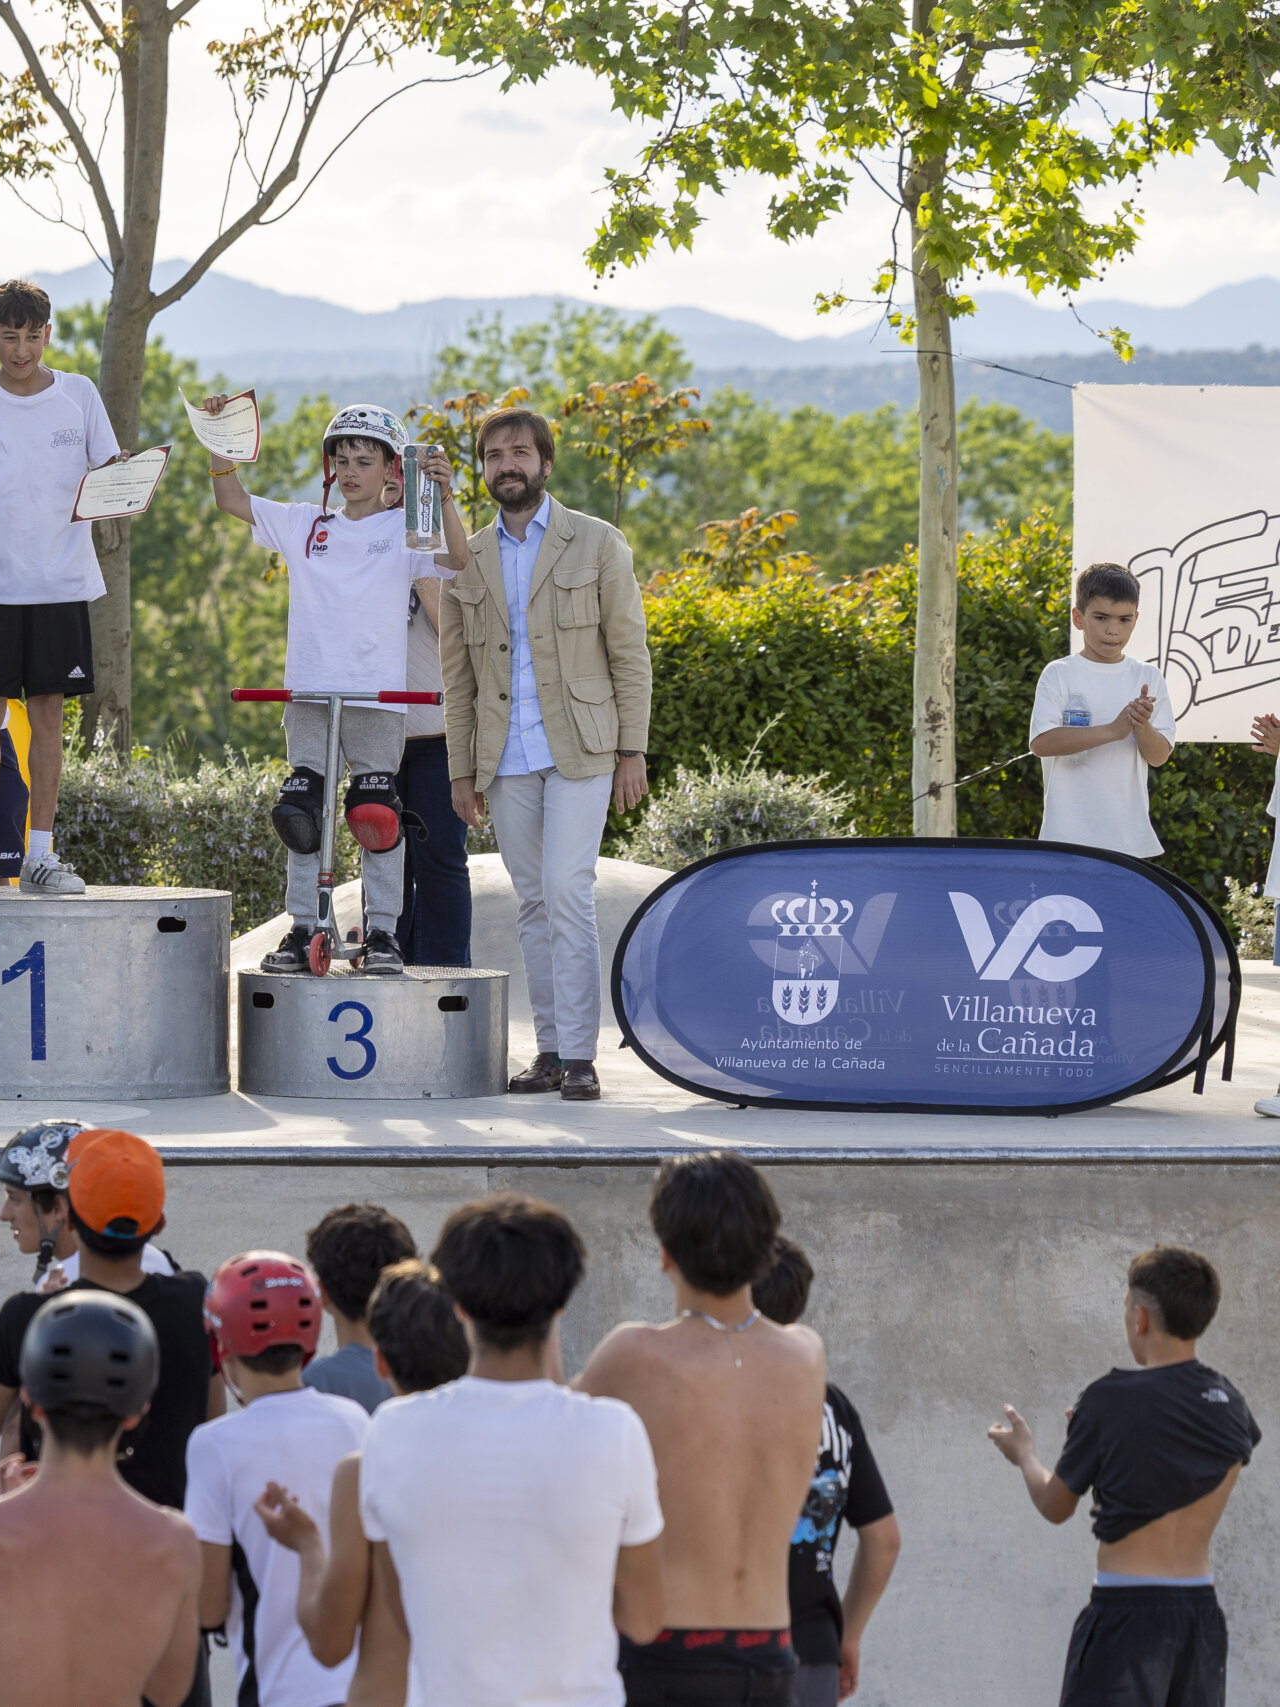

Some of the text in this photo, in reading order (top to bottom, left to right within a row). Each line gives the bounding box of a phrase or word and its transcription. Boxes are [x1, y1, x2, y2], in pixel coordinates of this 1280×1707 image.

[286, 778, 309, 786] 187
[361, 776, 388, 784] 187
[948, 891, 1103, 982] VC
[2, 941, 47, 1061] 1
[941, 995, 1096, 1026] Villanueva
[327, 1000, 377, 1081] 3
[741, 1038, 862, 1051] Ayuntamiento de
[937, 1027, 1094, 1057] de la Cañada
[715, 1056, 885, 1070] Villanueva de la Cañada
[934, 1063, 1094, 1078] SENCILLAMENTE TODO
